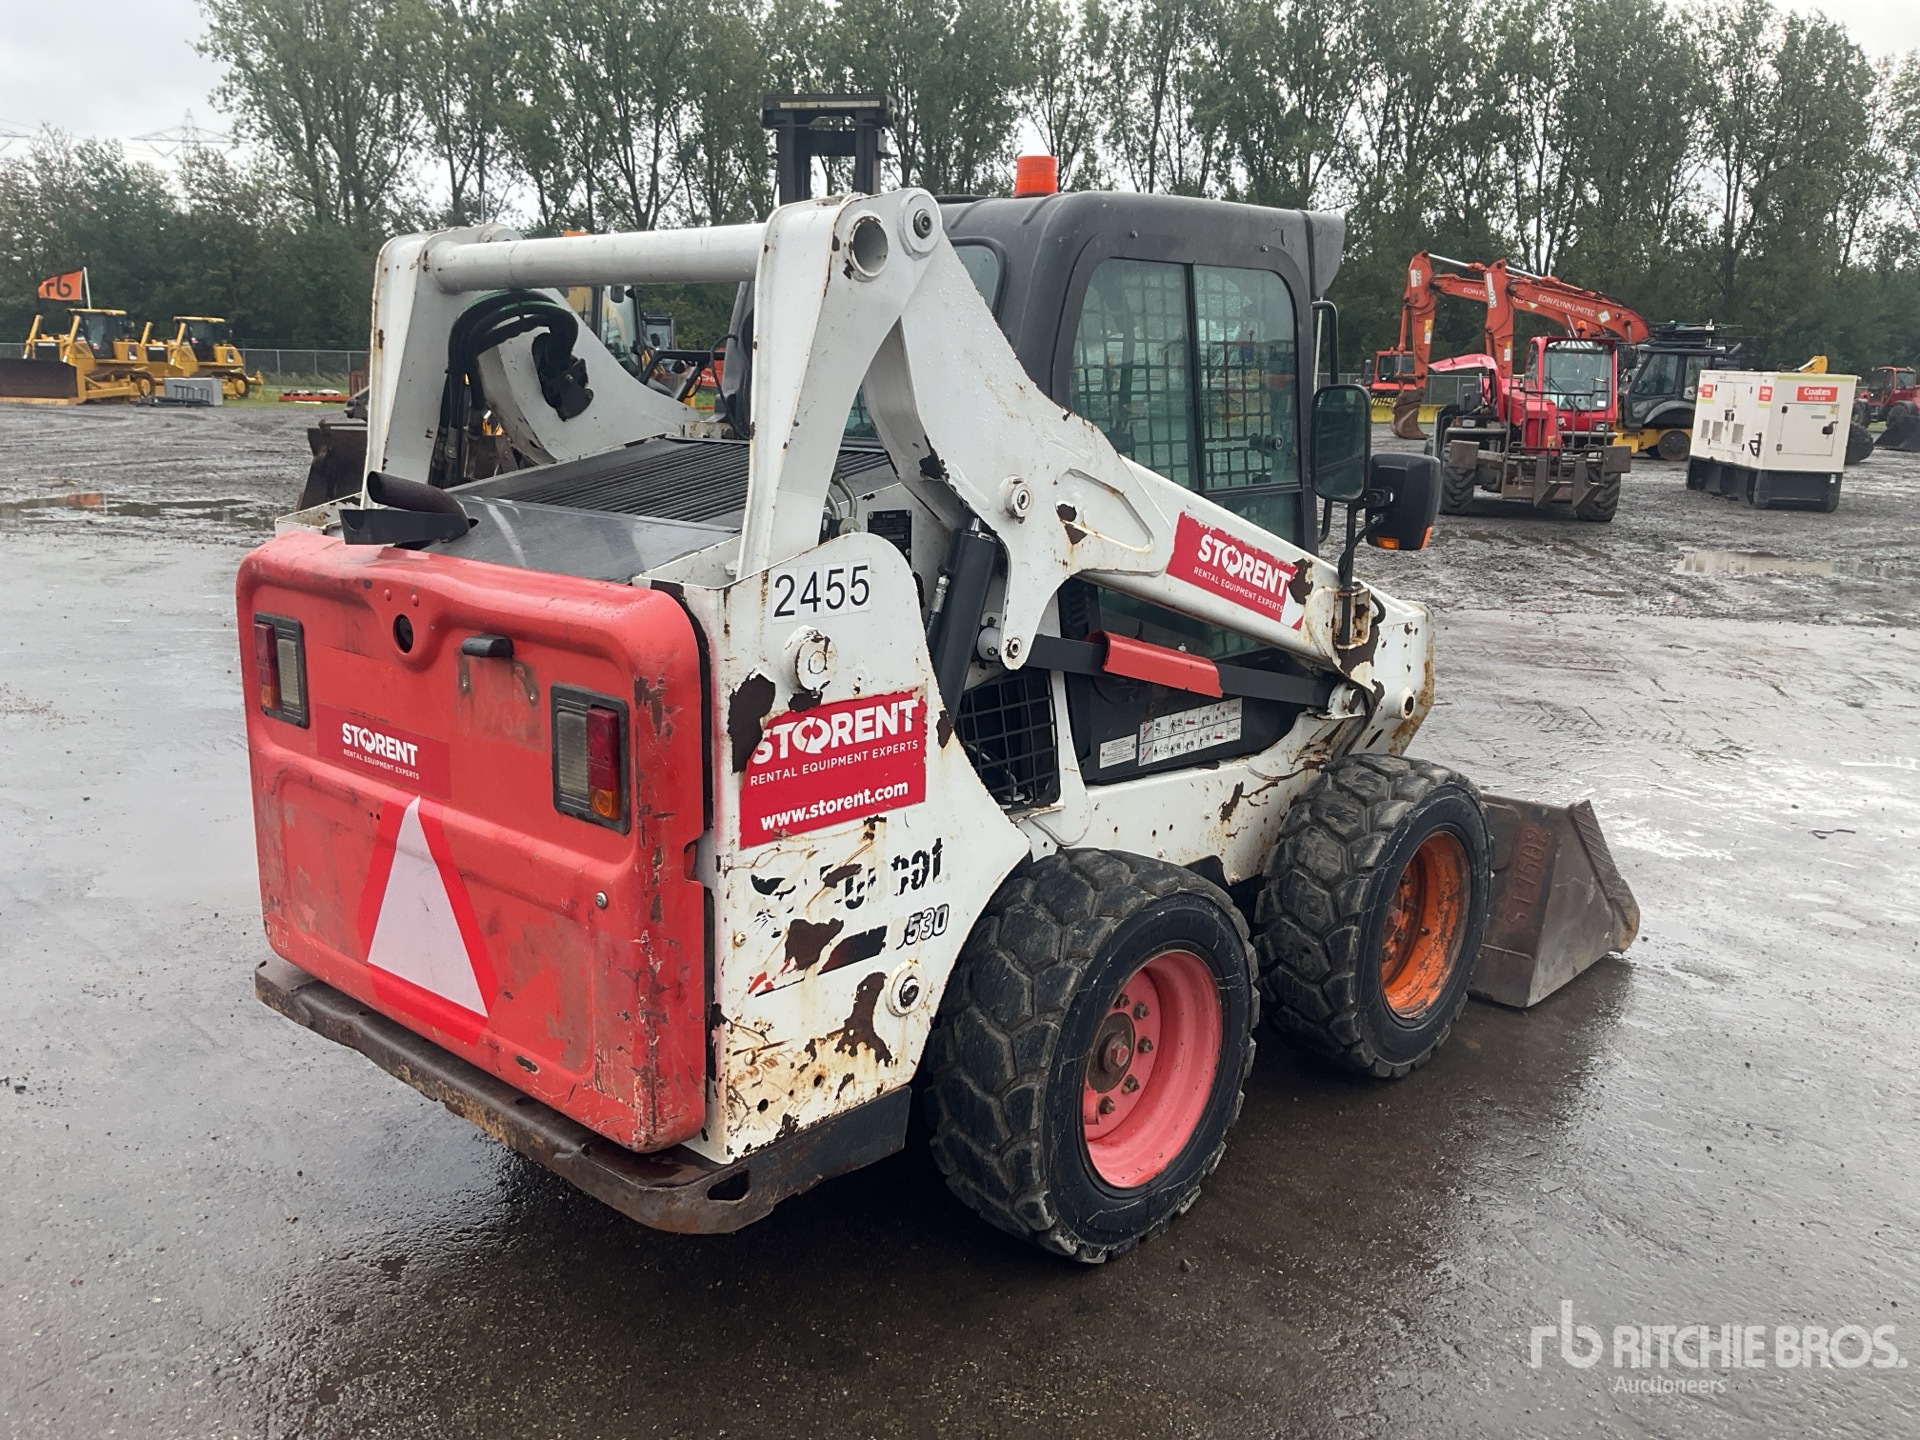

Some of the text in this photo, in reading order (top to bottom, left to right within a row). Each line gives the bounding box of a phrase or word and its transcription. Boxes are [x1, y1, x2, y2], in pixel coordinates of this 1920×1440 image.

[1803, 387, 1831, 397] Coates
[1193, 566, 1284, 613] RENTAL EQUIPMENT EXPERTS
[1197, 534, 1291, 598] STORENT
[774, 565, 870, 617] 2455
[342, 722, 418, 766] STORENT
[752, 700, 919, 765] STORENT
[343, 748, 420, 780] RENTAL EQUIPMENT EXPERTS
[750, 739, 919, 786] RENTAL EQUIPMENT EXPERTS
[760, 781, 909, 831] www.storent.com
[896, 903, 950, 950] 530
